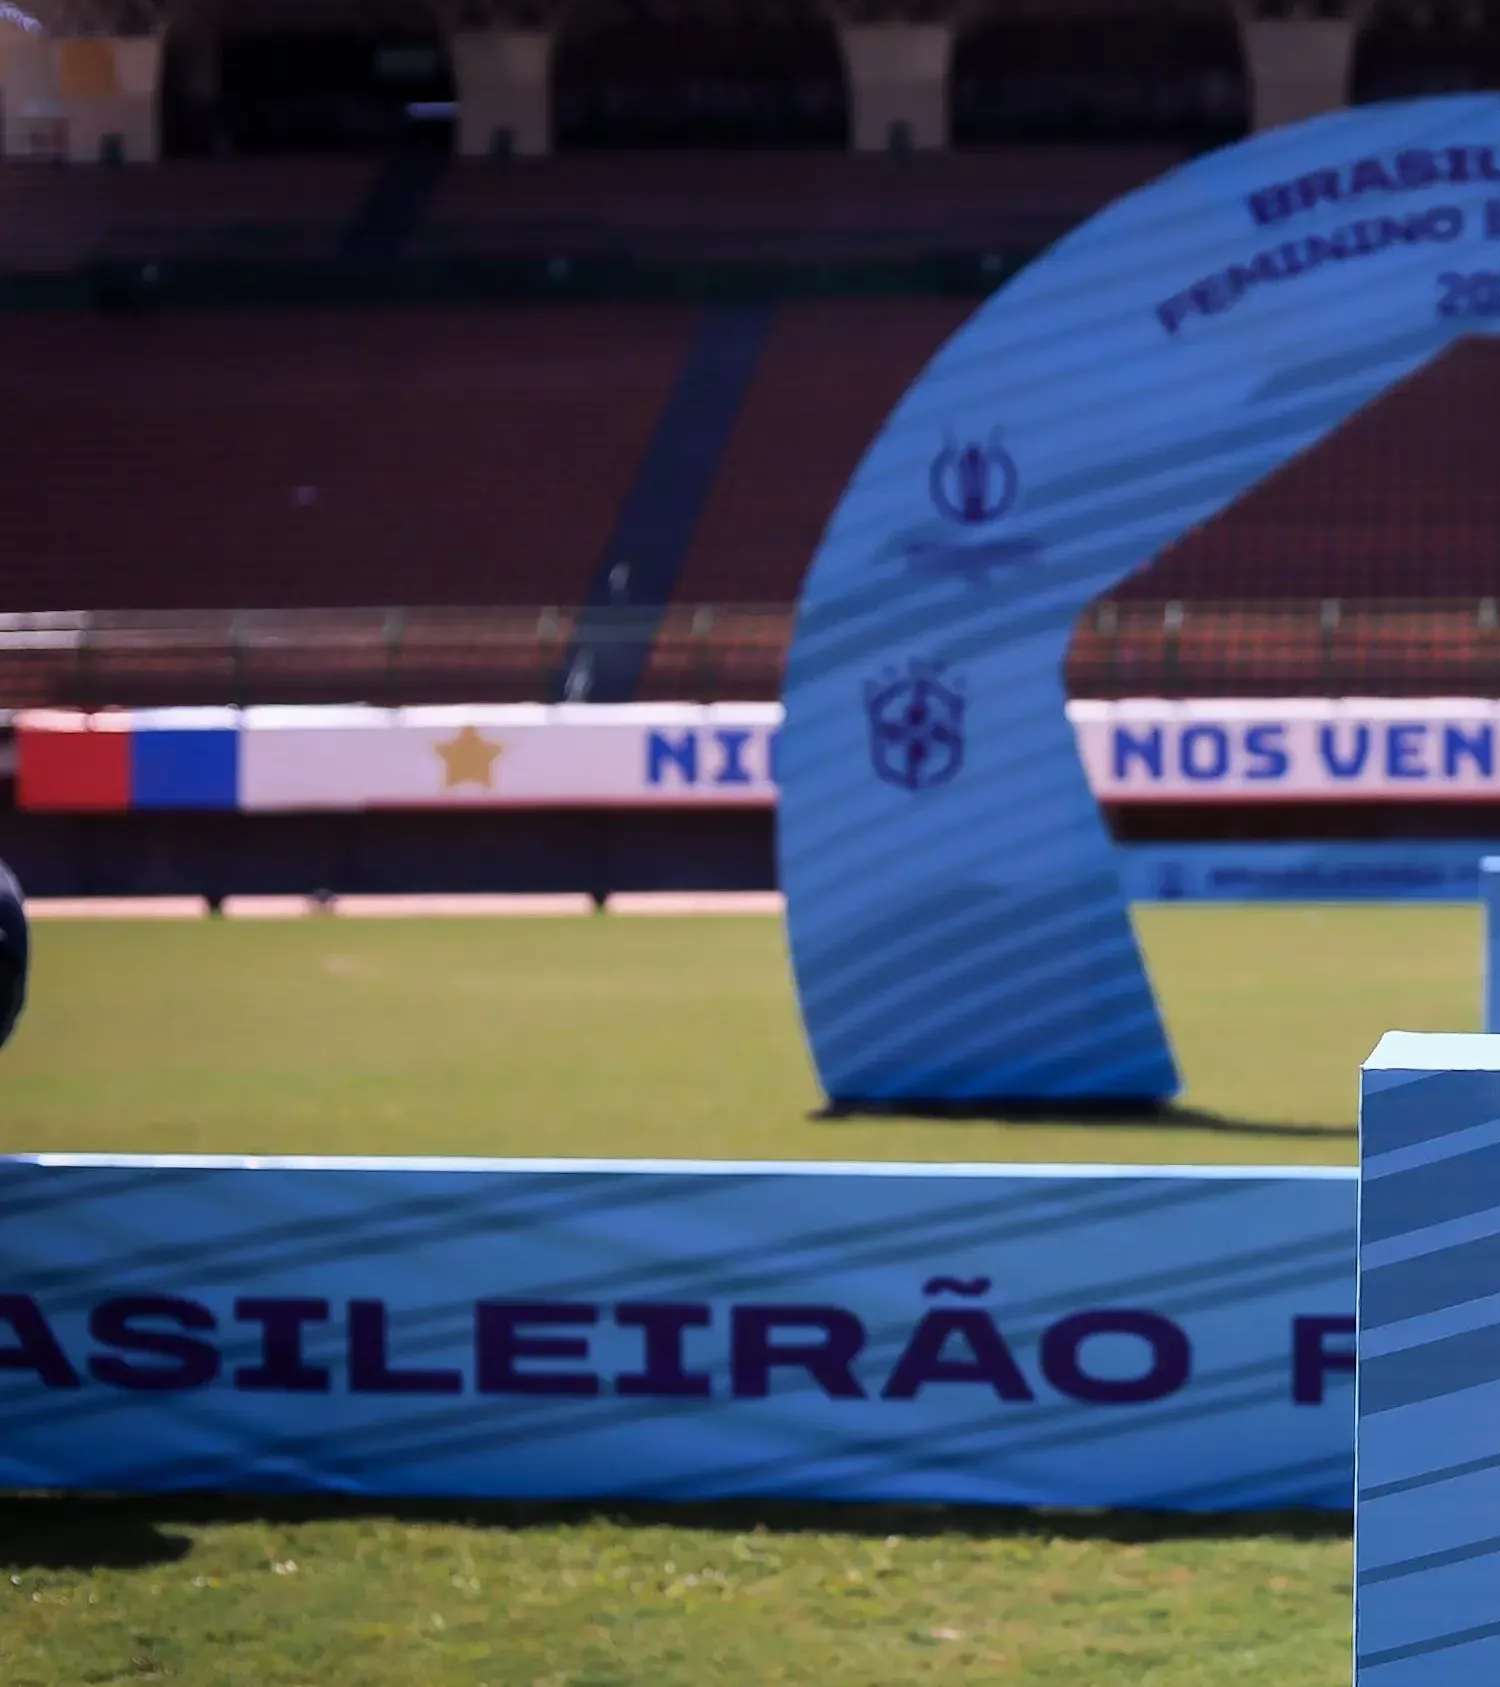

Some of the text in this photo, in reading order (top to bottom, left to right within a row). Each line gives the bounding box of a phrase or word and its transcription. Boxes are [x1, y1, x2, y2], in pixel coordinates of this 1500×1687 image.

[1156, 207, 1463, 335] FEMININO
[646, 727, 777, 786] NI
[1114, 725, 1290, 780] NOS
